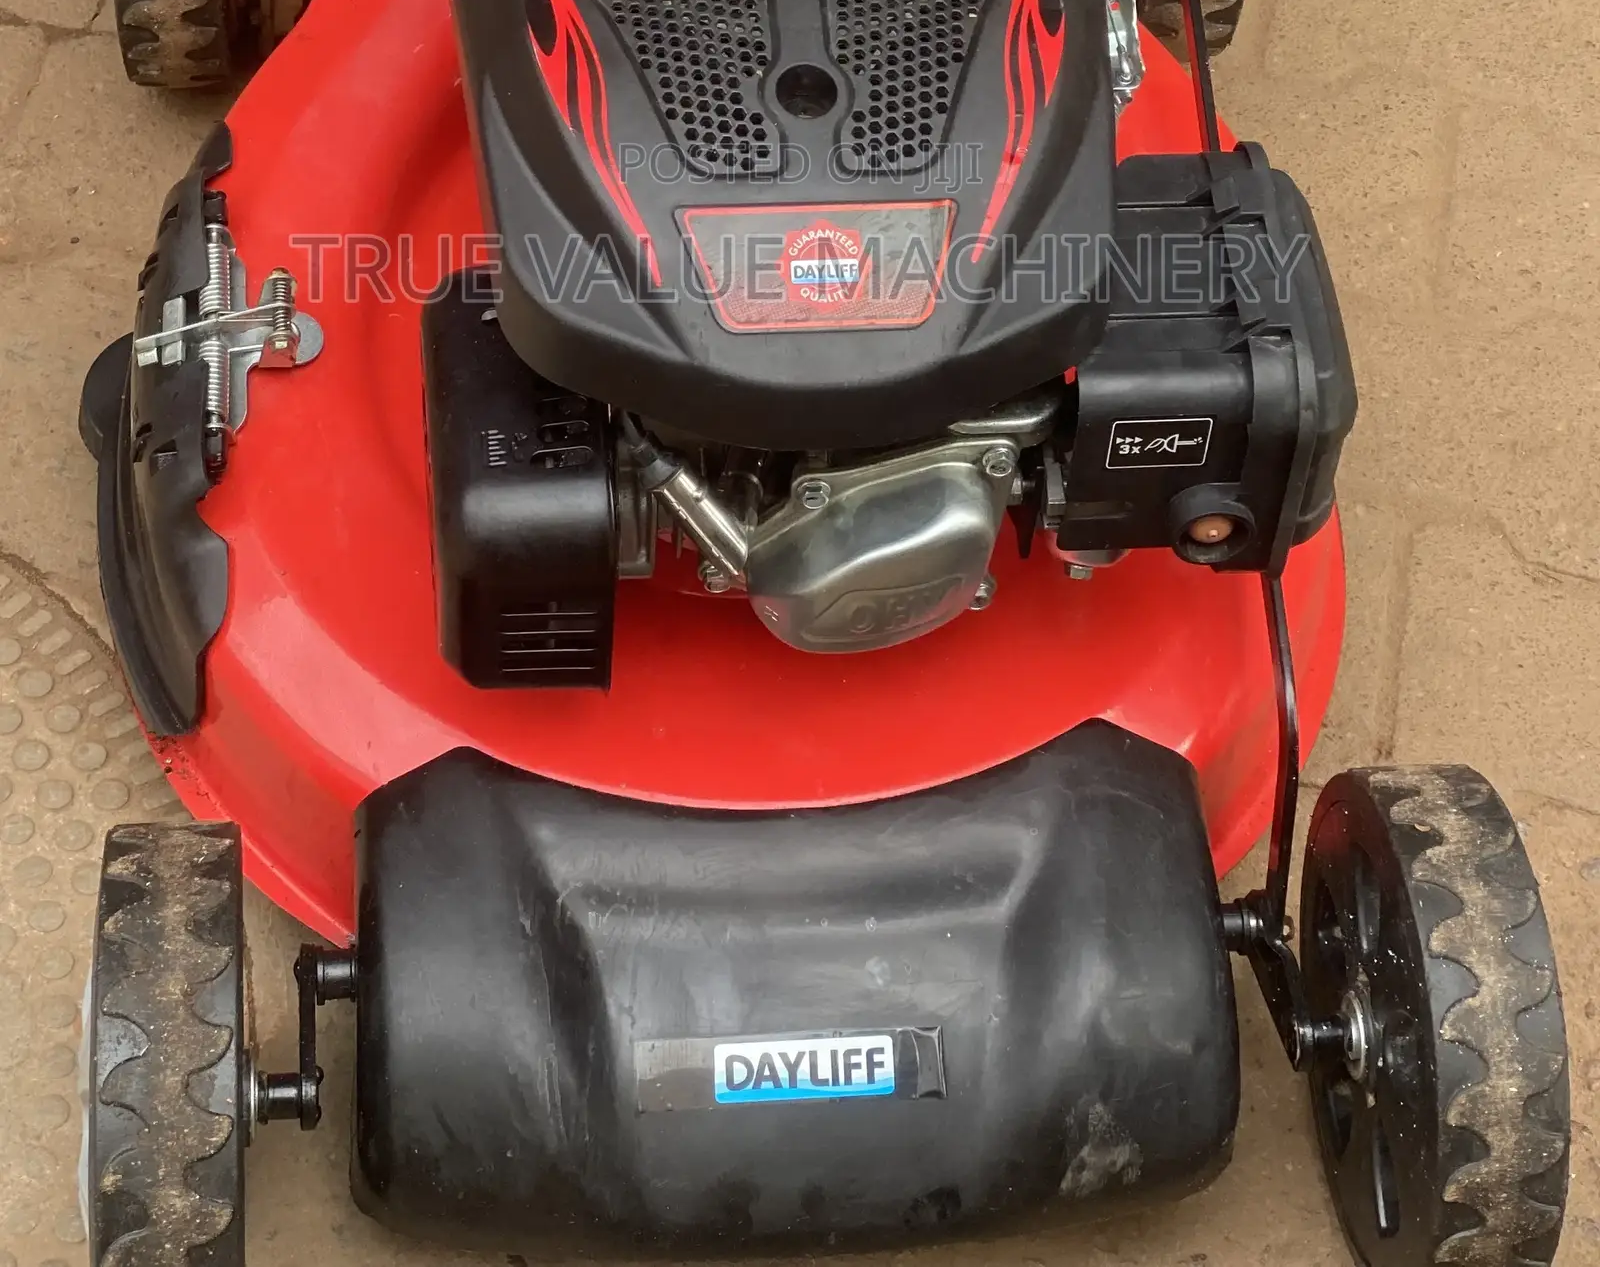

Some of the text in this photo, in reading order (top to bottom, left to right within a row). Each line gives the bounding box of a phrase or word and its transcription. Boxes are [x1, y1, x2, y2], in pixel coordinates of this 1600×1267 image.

[788, 228, 859, 256] GUARANTEED
[793, 263, 858, 279] DAYLIFF
[800, 287, 850, 303] QUALITY
[1118, 444, 1141, 455] 3x
[725, 1046, 886, 1091] DAYLIFF
